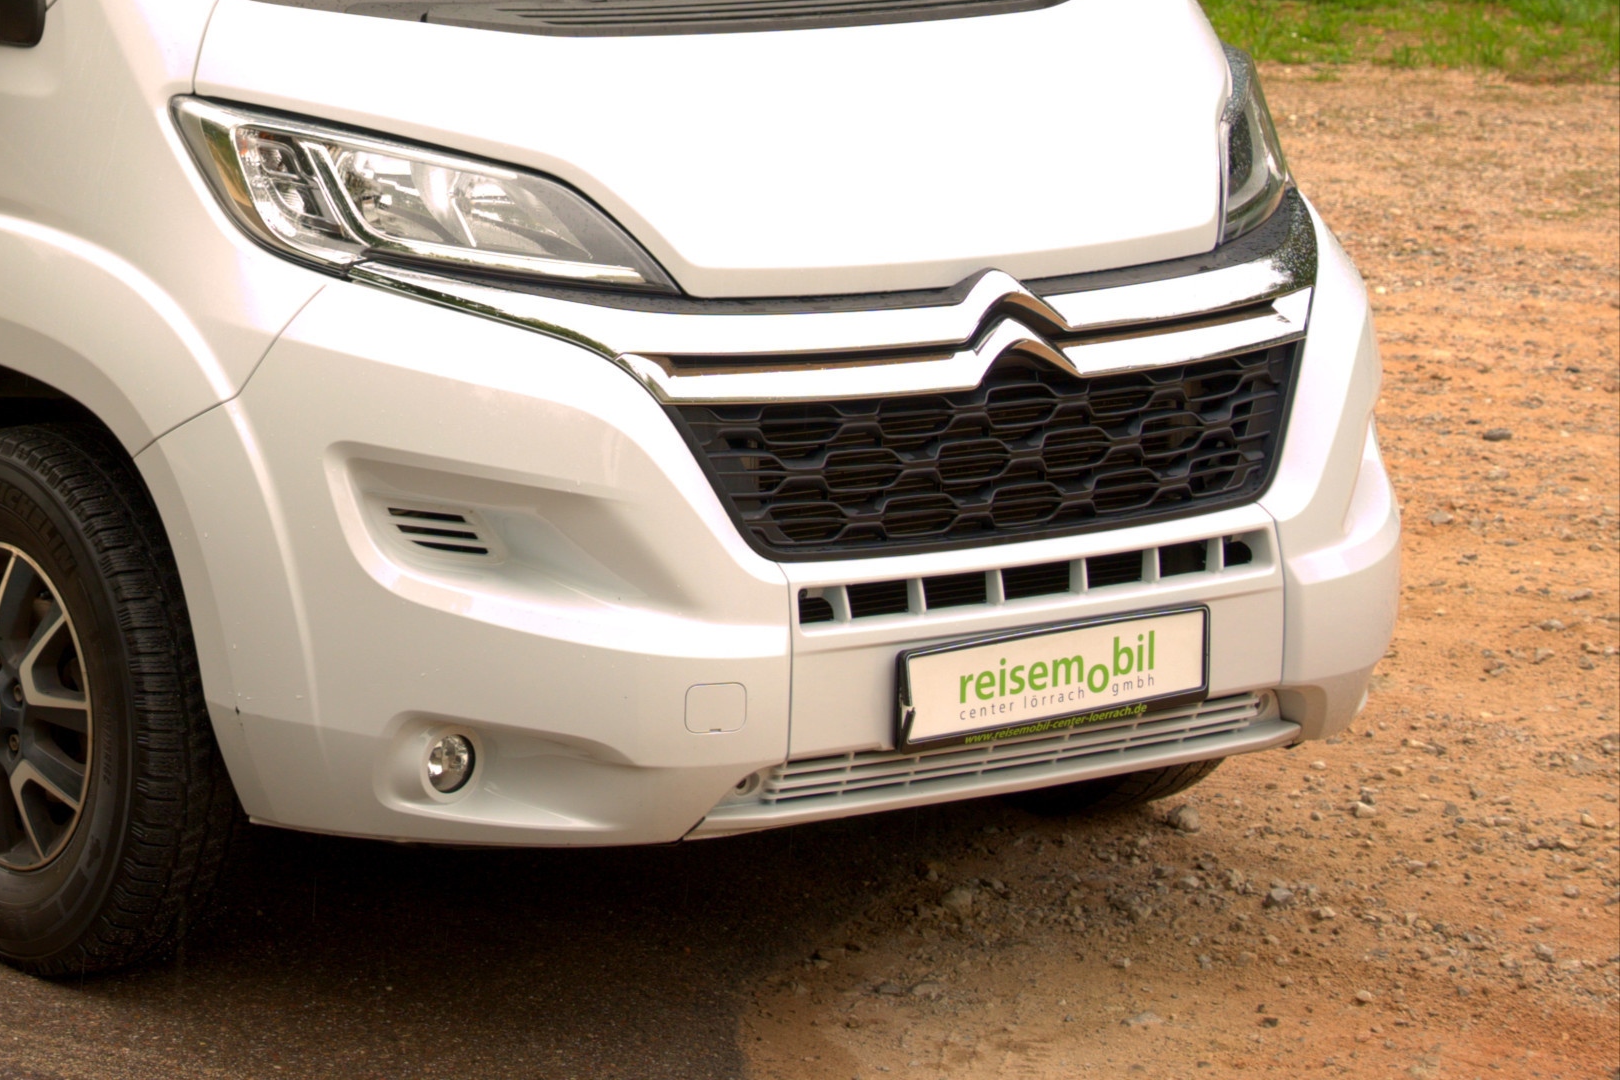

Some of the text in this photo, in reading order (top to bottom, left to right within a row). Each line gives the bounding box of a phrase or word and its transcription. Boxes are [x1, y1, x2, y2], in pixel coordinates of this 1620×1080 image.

[959, 630, 1156, 704] reisemobil
[959, 674, 1155, 721] center lörrach gmbh
[964, 702, 1148, 745] www.reisemobil-center-loerrach.de
